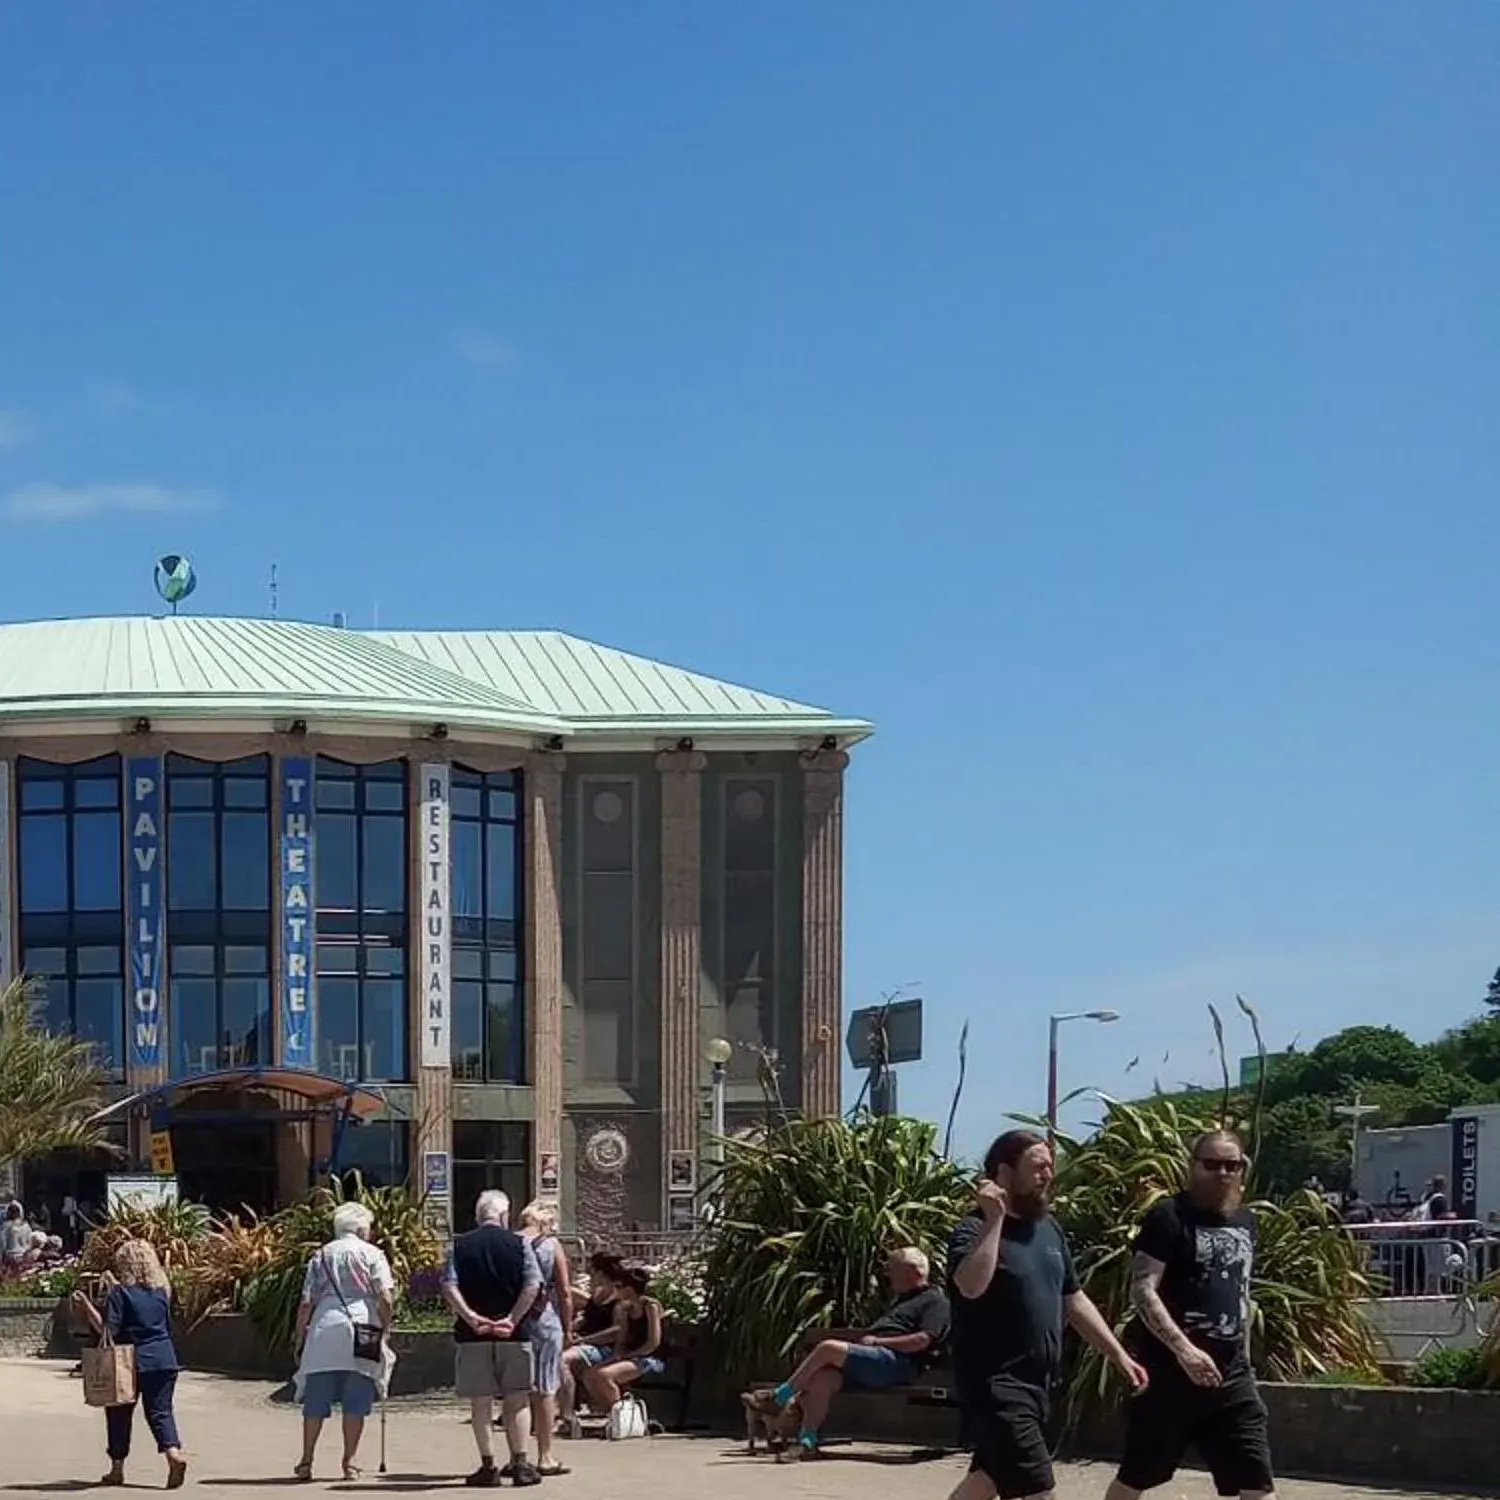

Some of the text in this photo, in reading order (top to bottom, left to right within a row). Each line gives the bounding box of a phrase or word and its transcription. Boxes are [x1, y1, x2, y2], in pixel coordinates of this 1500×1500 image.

[133, 776, 157, 1047] PAVILION
[286, 778, 308, 1012] THEATRE
[427, 777, 445, 1048] RESTAURANT
[1461, 1121, 1476, 1206] TOILETS
